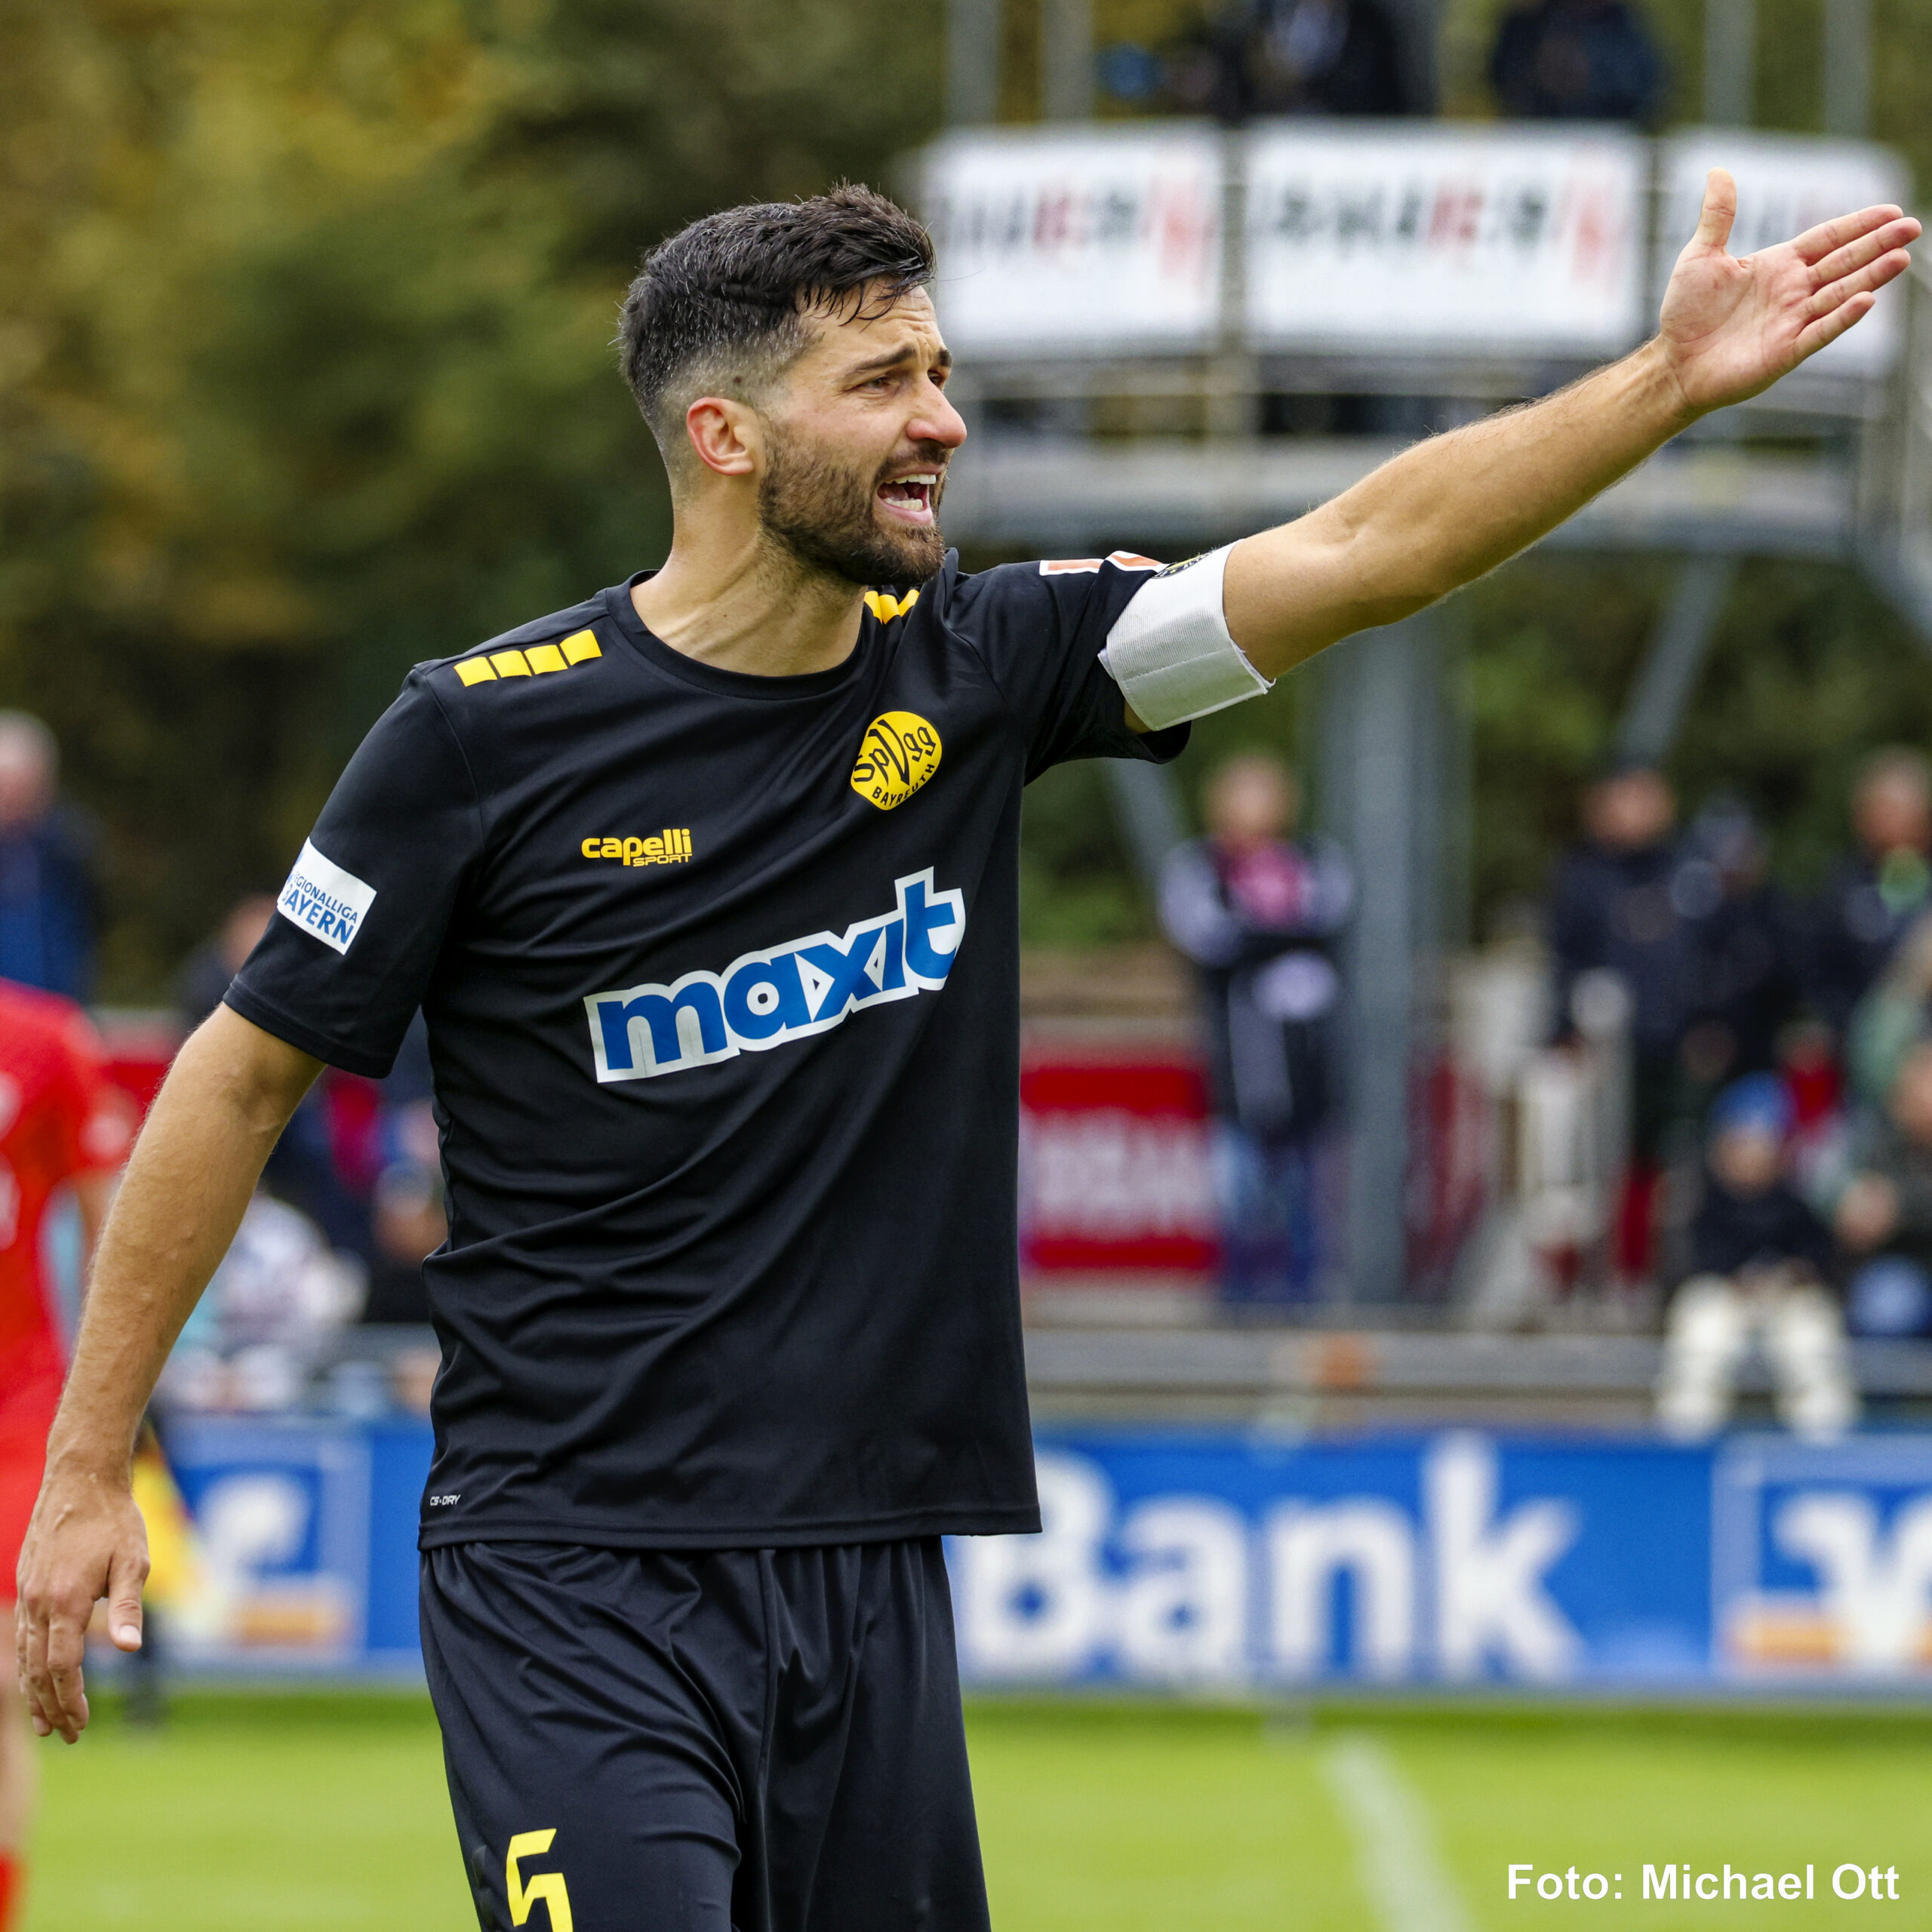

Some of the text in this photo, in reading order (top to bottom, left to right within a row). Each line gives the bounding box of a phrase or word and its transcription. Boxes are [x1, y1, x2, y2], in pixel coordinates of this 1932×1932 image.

[872, 764, 935, 806] BAYREUTH
[581, 829, 692, 866] capelli
[633, 854, 692, 866] SPORT
[294, 871, 358, 924] GIONALLIGA
[594, 875, 958, 1073] maxit
[958, 1429, 1579, 1681] Bank
[506, 1828, 574, 1932] 5
